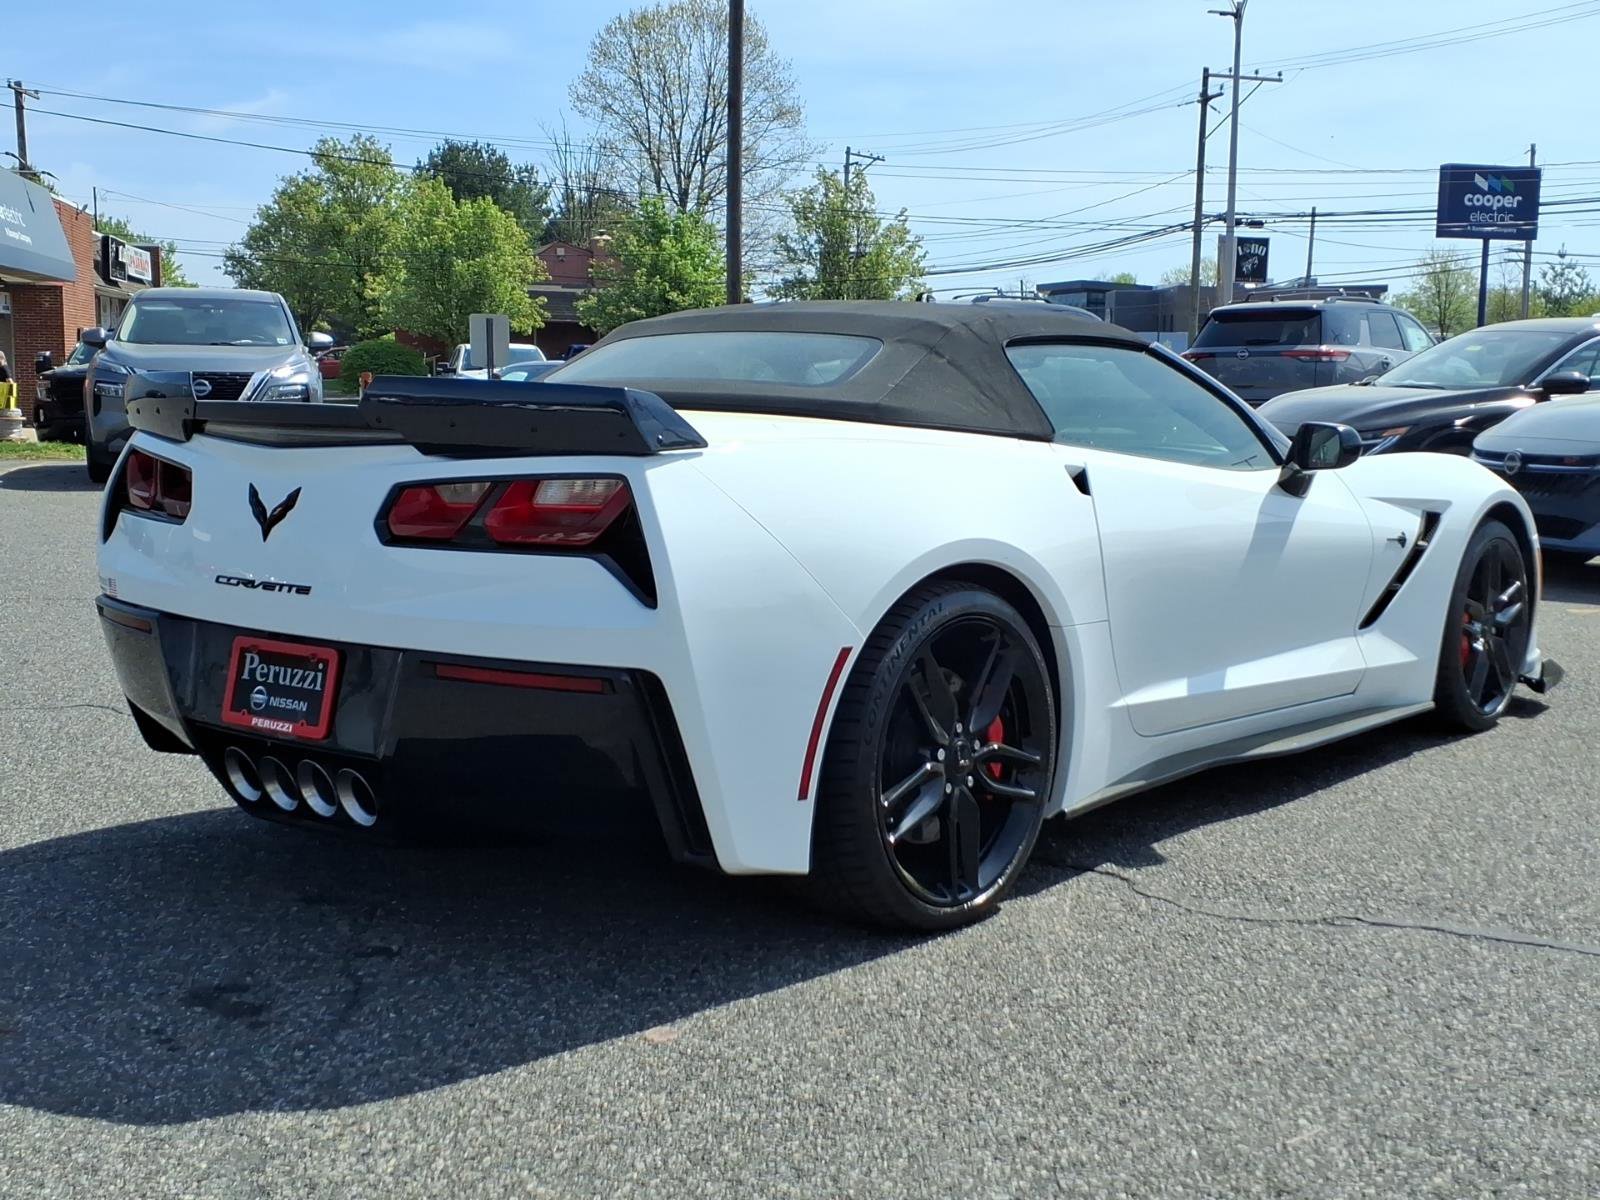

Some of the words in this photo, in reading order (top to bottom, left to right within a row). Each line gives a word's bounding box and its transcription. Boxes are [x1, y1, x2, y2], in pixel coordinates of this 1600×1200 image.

[1464, 194, 1523, 210] cooper
[1470, 211, 1514, 223] electric
[215, 575, 312, 595] CORVETTE
[241, 652, 323, 691] Peruzzi
[269, 696, 308, 712] NISSAN
[251, 717, 293, 733] PERUZZI
